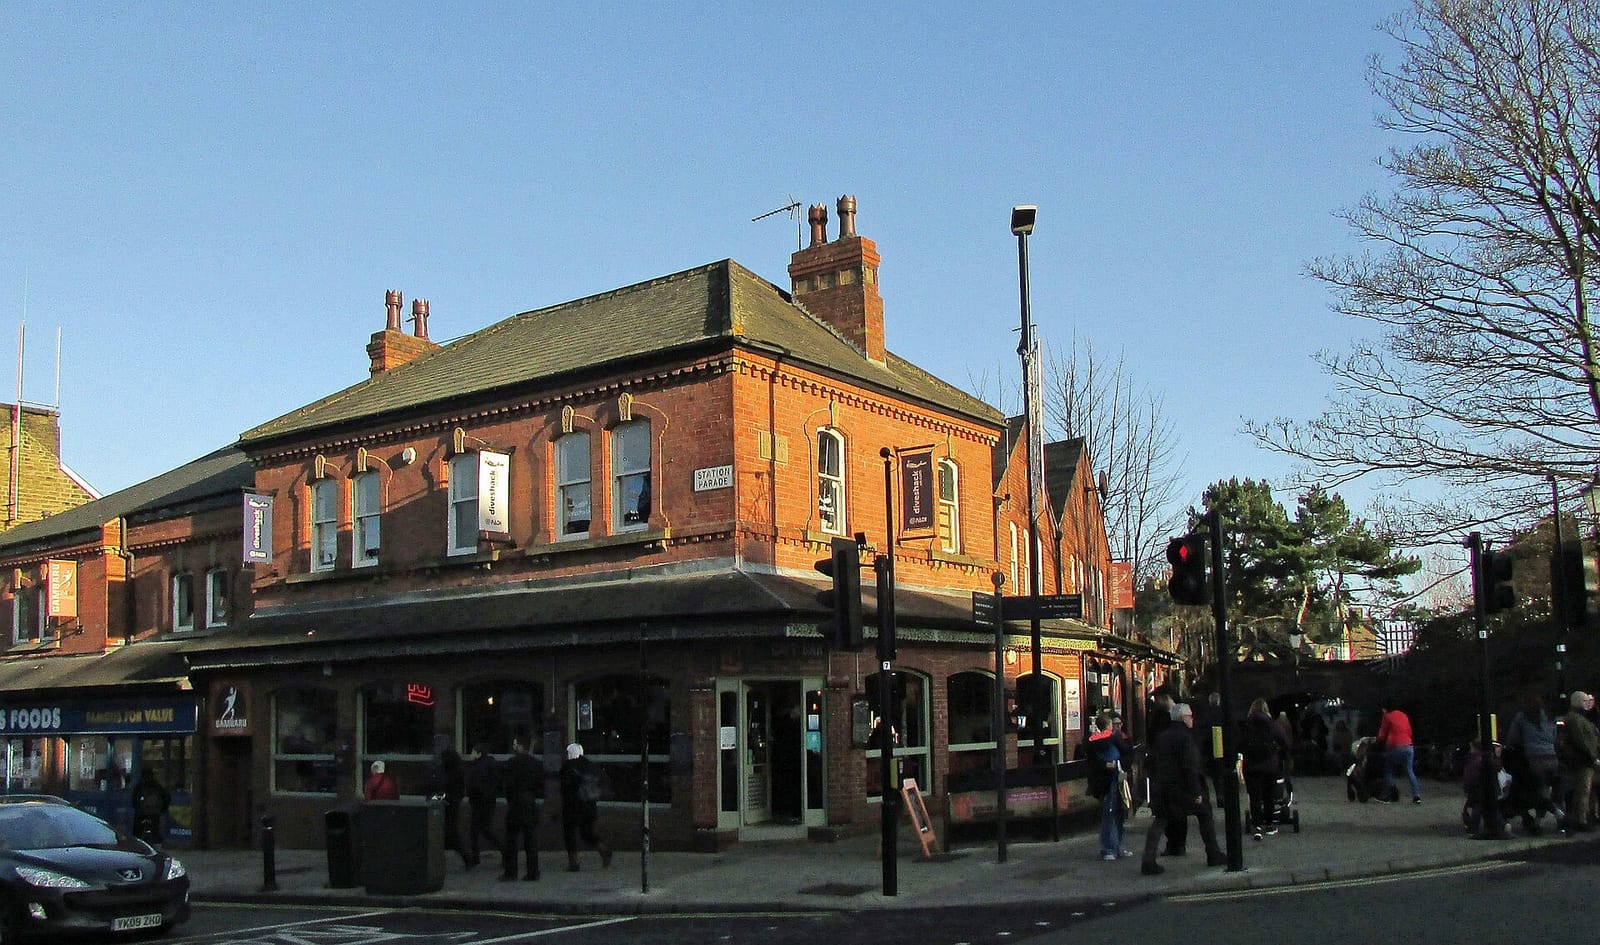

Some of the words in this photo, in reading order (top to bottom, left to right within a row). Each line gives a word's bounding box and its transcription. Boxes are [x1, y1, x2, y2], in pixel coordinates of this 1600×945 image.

[697, 467, 730, 480] STATION
[698, 477, 728, 489] PARADE
[488, 470, 496, 515] diveshack
[912, 470, 920, 514] diveshack
[252, 509, 260, 549] diveshack
[51, 564, 60, 612] GAMBARU
[10, 707, 61, 730] FOODS
[125, 710, 142, 723] FOR
[144, 708, 174, 722] VALUE
